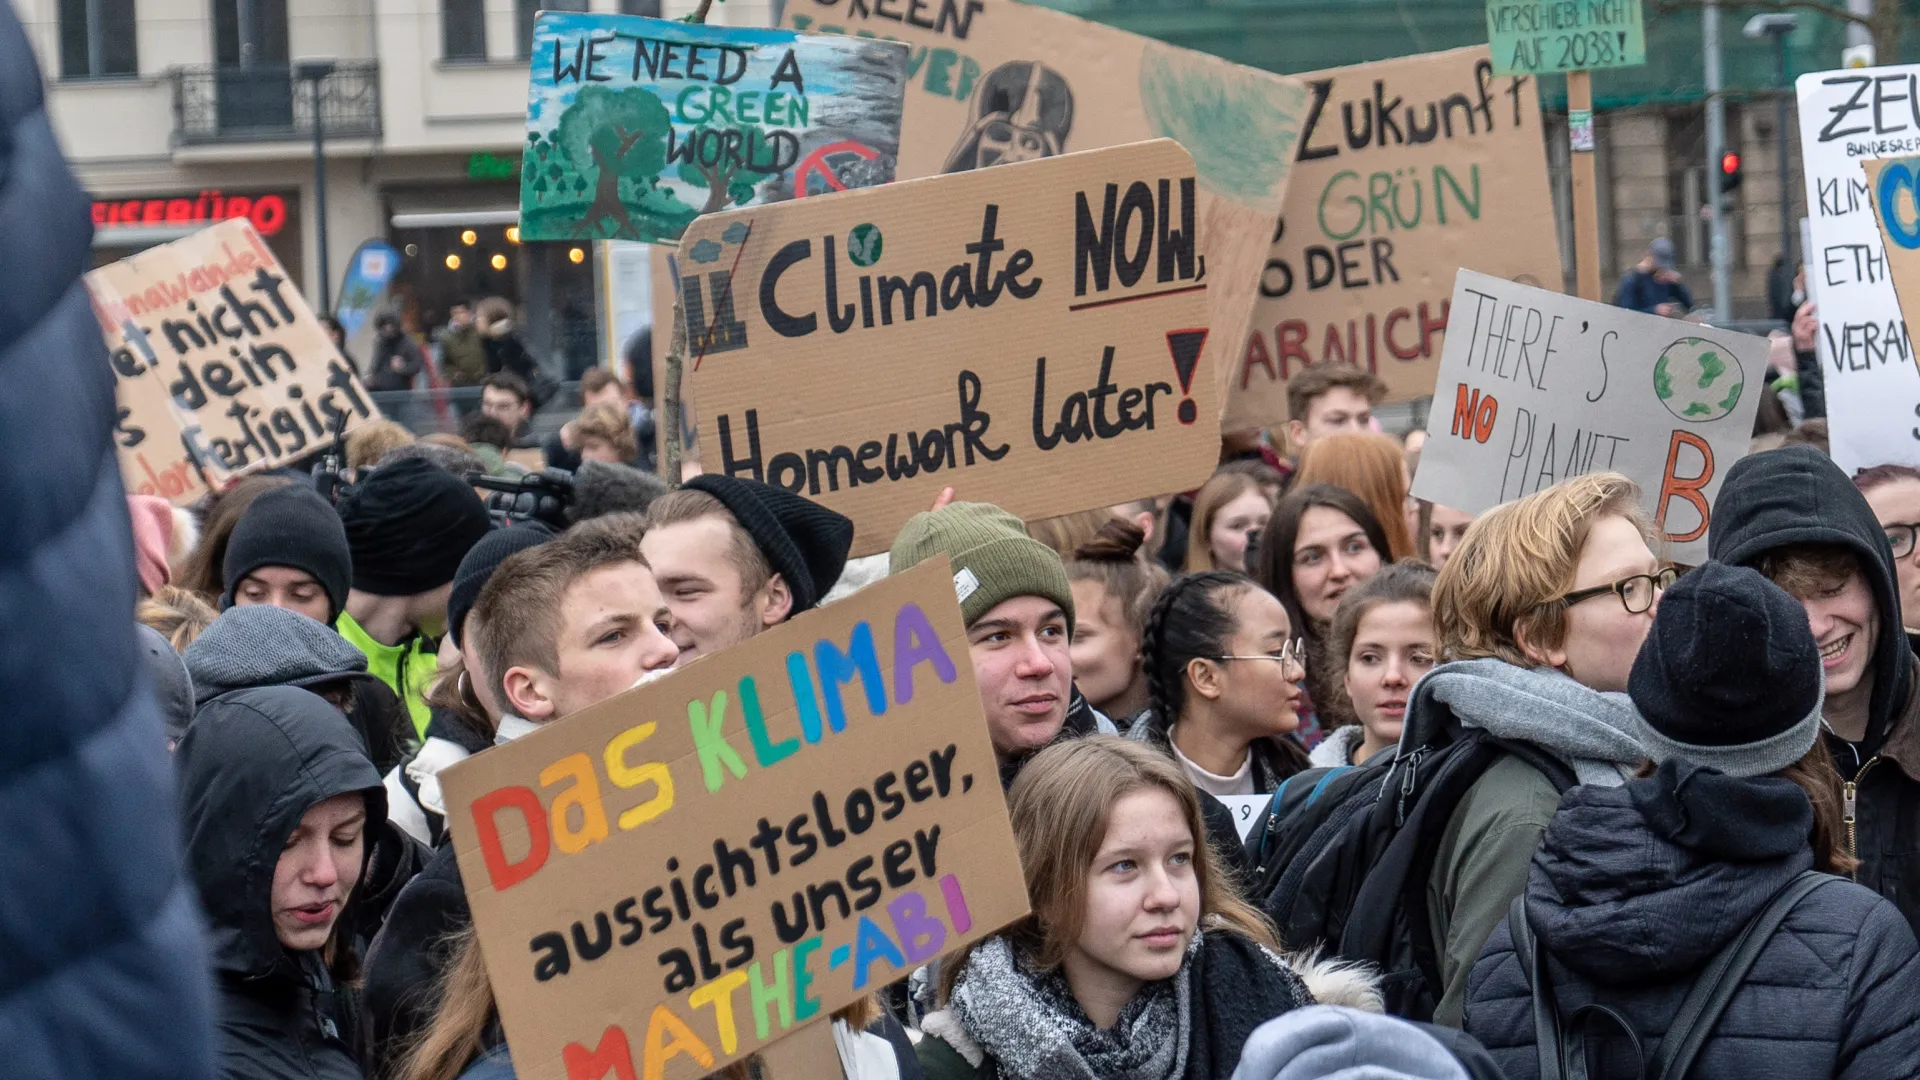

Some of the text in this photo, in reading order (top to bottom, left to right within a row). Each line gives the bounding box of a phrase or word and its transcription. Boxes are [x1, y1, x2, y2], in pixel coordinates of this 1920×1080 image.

[553, 30, 804, 95] WE NEED A
[814, 0, 984, 40] REEN
[1510, 30, 1627, 71] AUF 2038!
[675, 84, 810, 128] GREEN
[1295, 58, 1529, 162] Zukunft
[666, 126, 800, 174] WORLD
[1317, 164, 1481, 241] GRÜN
[759, 177, 1206, 338] Climate NOW,
[1260, 237, 1400, 298] ODER
[1824, 243, 1884, 287] ETH
[162, 267, 296, 353] nicht
[1464, 288, 1619, 403] THERE'S
[170, 346, 297, 411] dein
[717, 327, 1209, 496] Homework Later!
[1451, 382, 1498, 444] NO
[1654, 429, 1715, 543] B
[687, 602, 957, 794] KLIMA
[529, 743, 974, 983] aussichtsloser,
[658, 824, 941, 995] als unser
[561, 872, 972, 1080] MATHE-ABI
